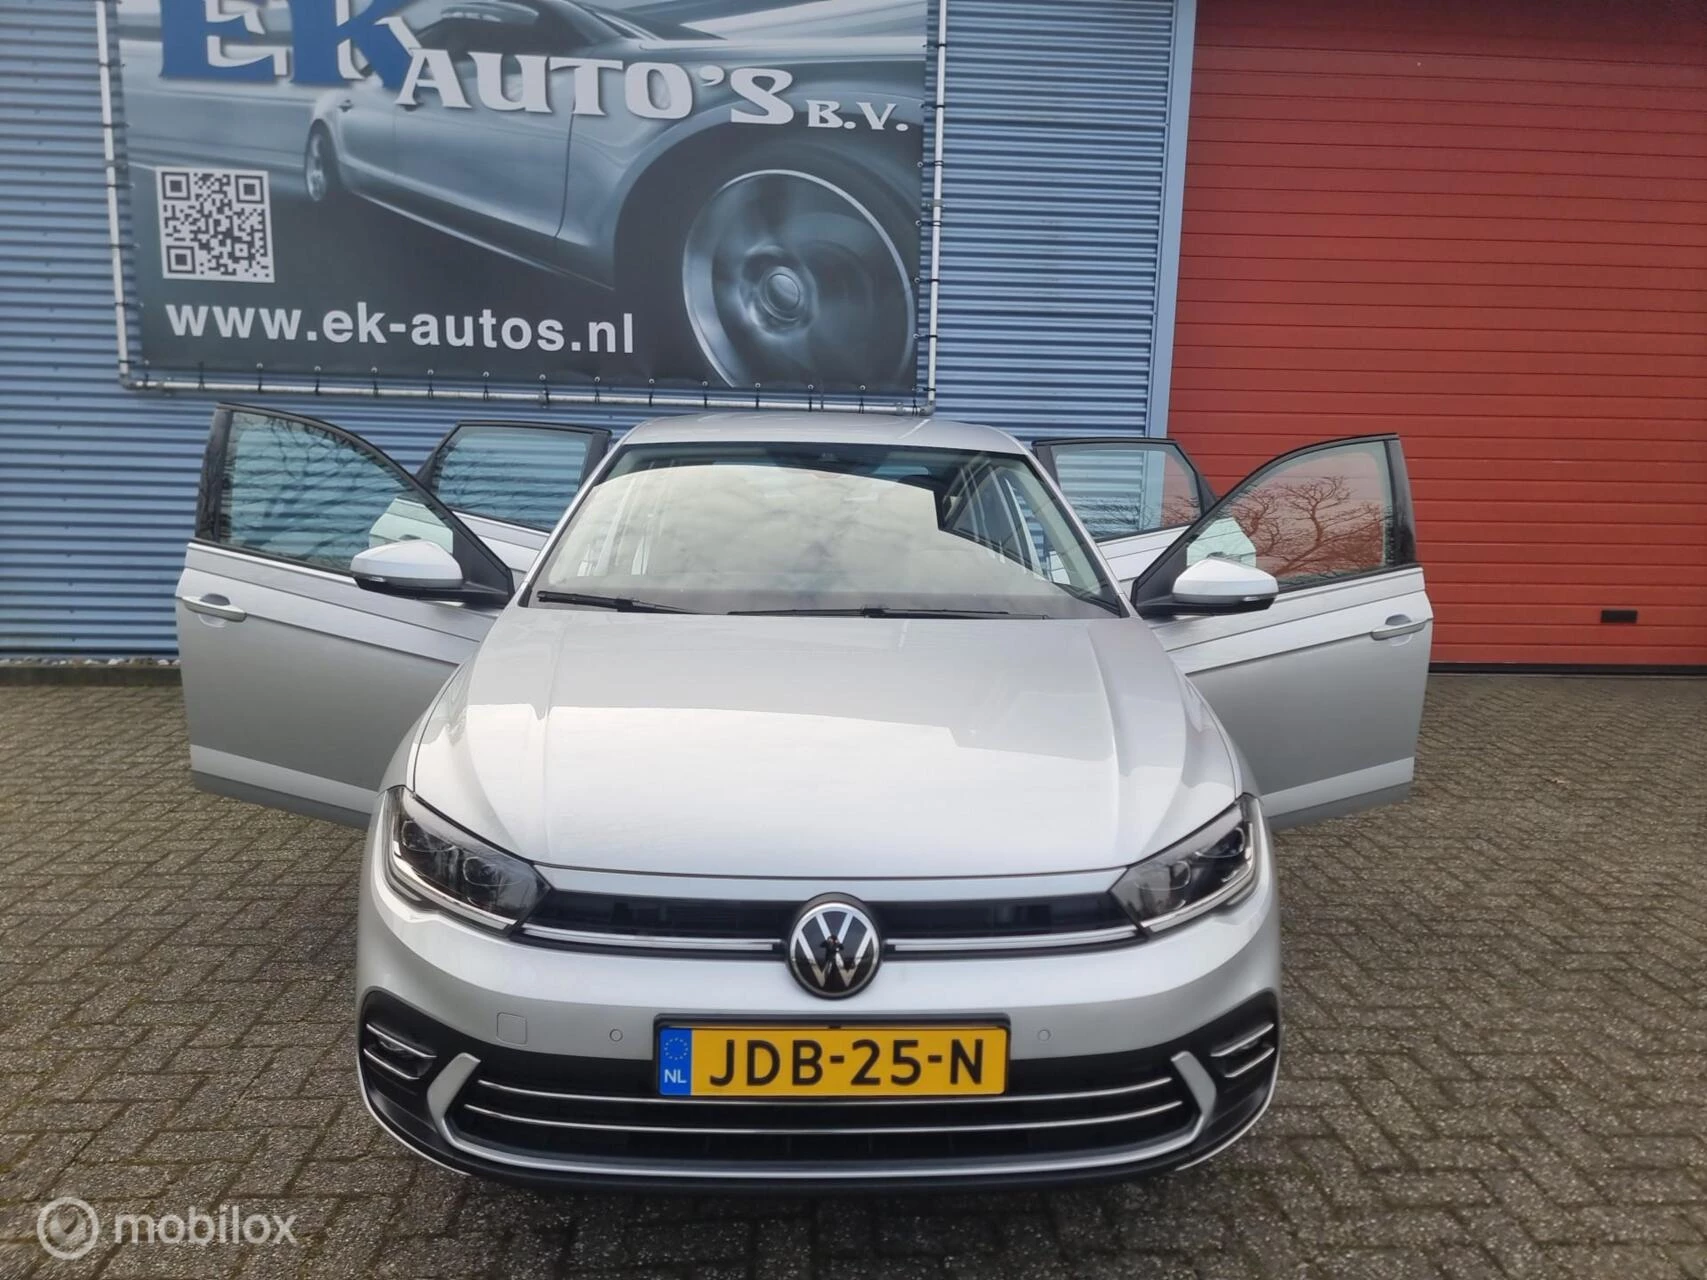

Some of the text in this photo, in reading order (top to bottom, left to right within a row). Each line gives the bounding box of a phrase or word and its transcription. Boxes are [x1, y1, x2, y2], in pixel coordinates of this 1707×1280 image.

[159, 0, 418, 90] EK
[806, 98, 910, 132] B.V.
[166, 302, 634, 354] www.ek-autos.nl
[664, 1069, 687, 1084] NL
[709, 1038, 984, 1087] JDB-25-N
